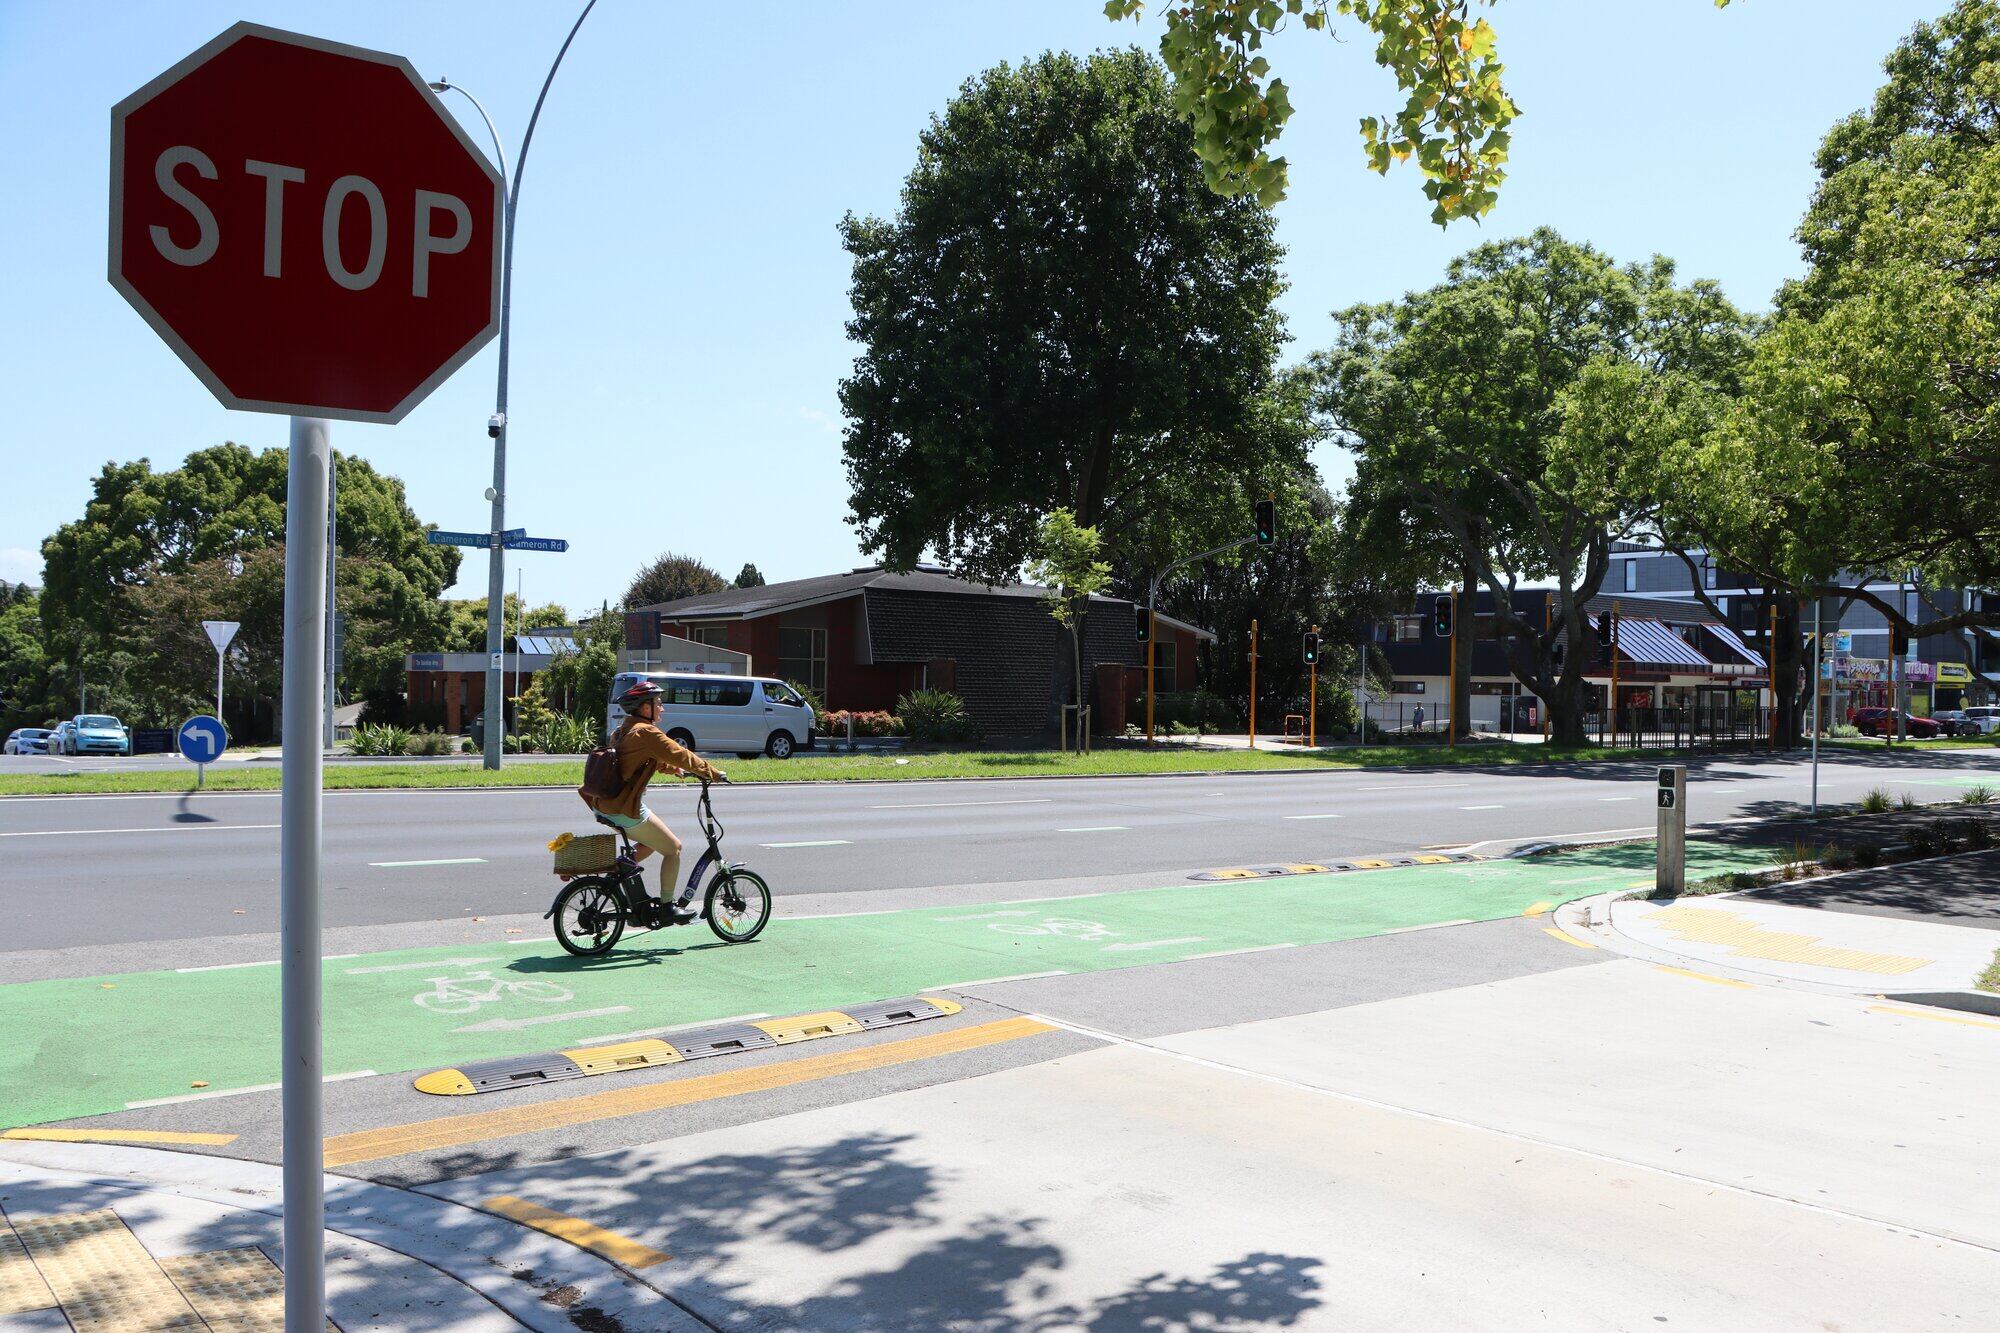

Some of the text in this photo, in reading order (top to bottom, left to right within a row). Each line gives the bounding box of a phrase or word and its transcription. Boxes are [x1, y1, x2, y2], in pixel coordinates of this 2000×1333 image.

[148, 145, 473, 298] STOP
[434, 533, 488, 545] Cameron Rd
[550, 541, 562, 550] Rd
